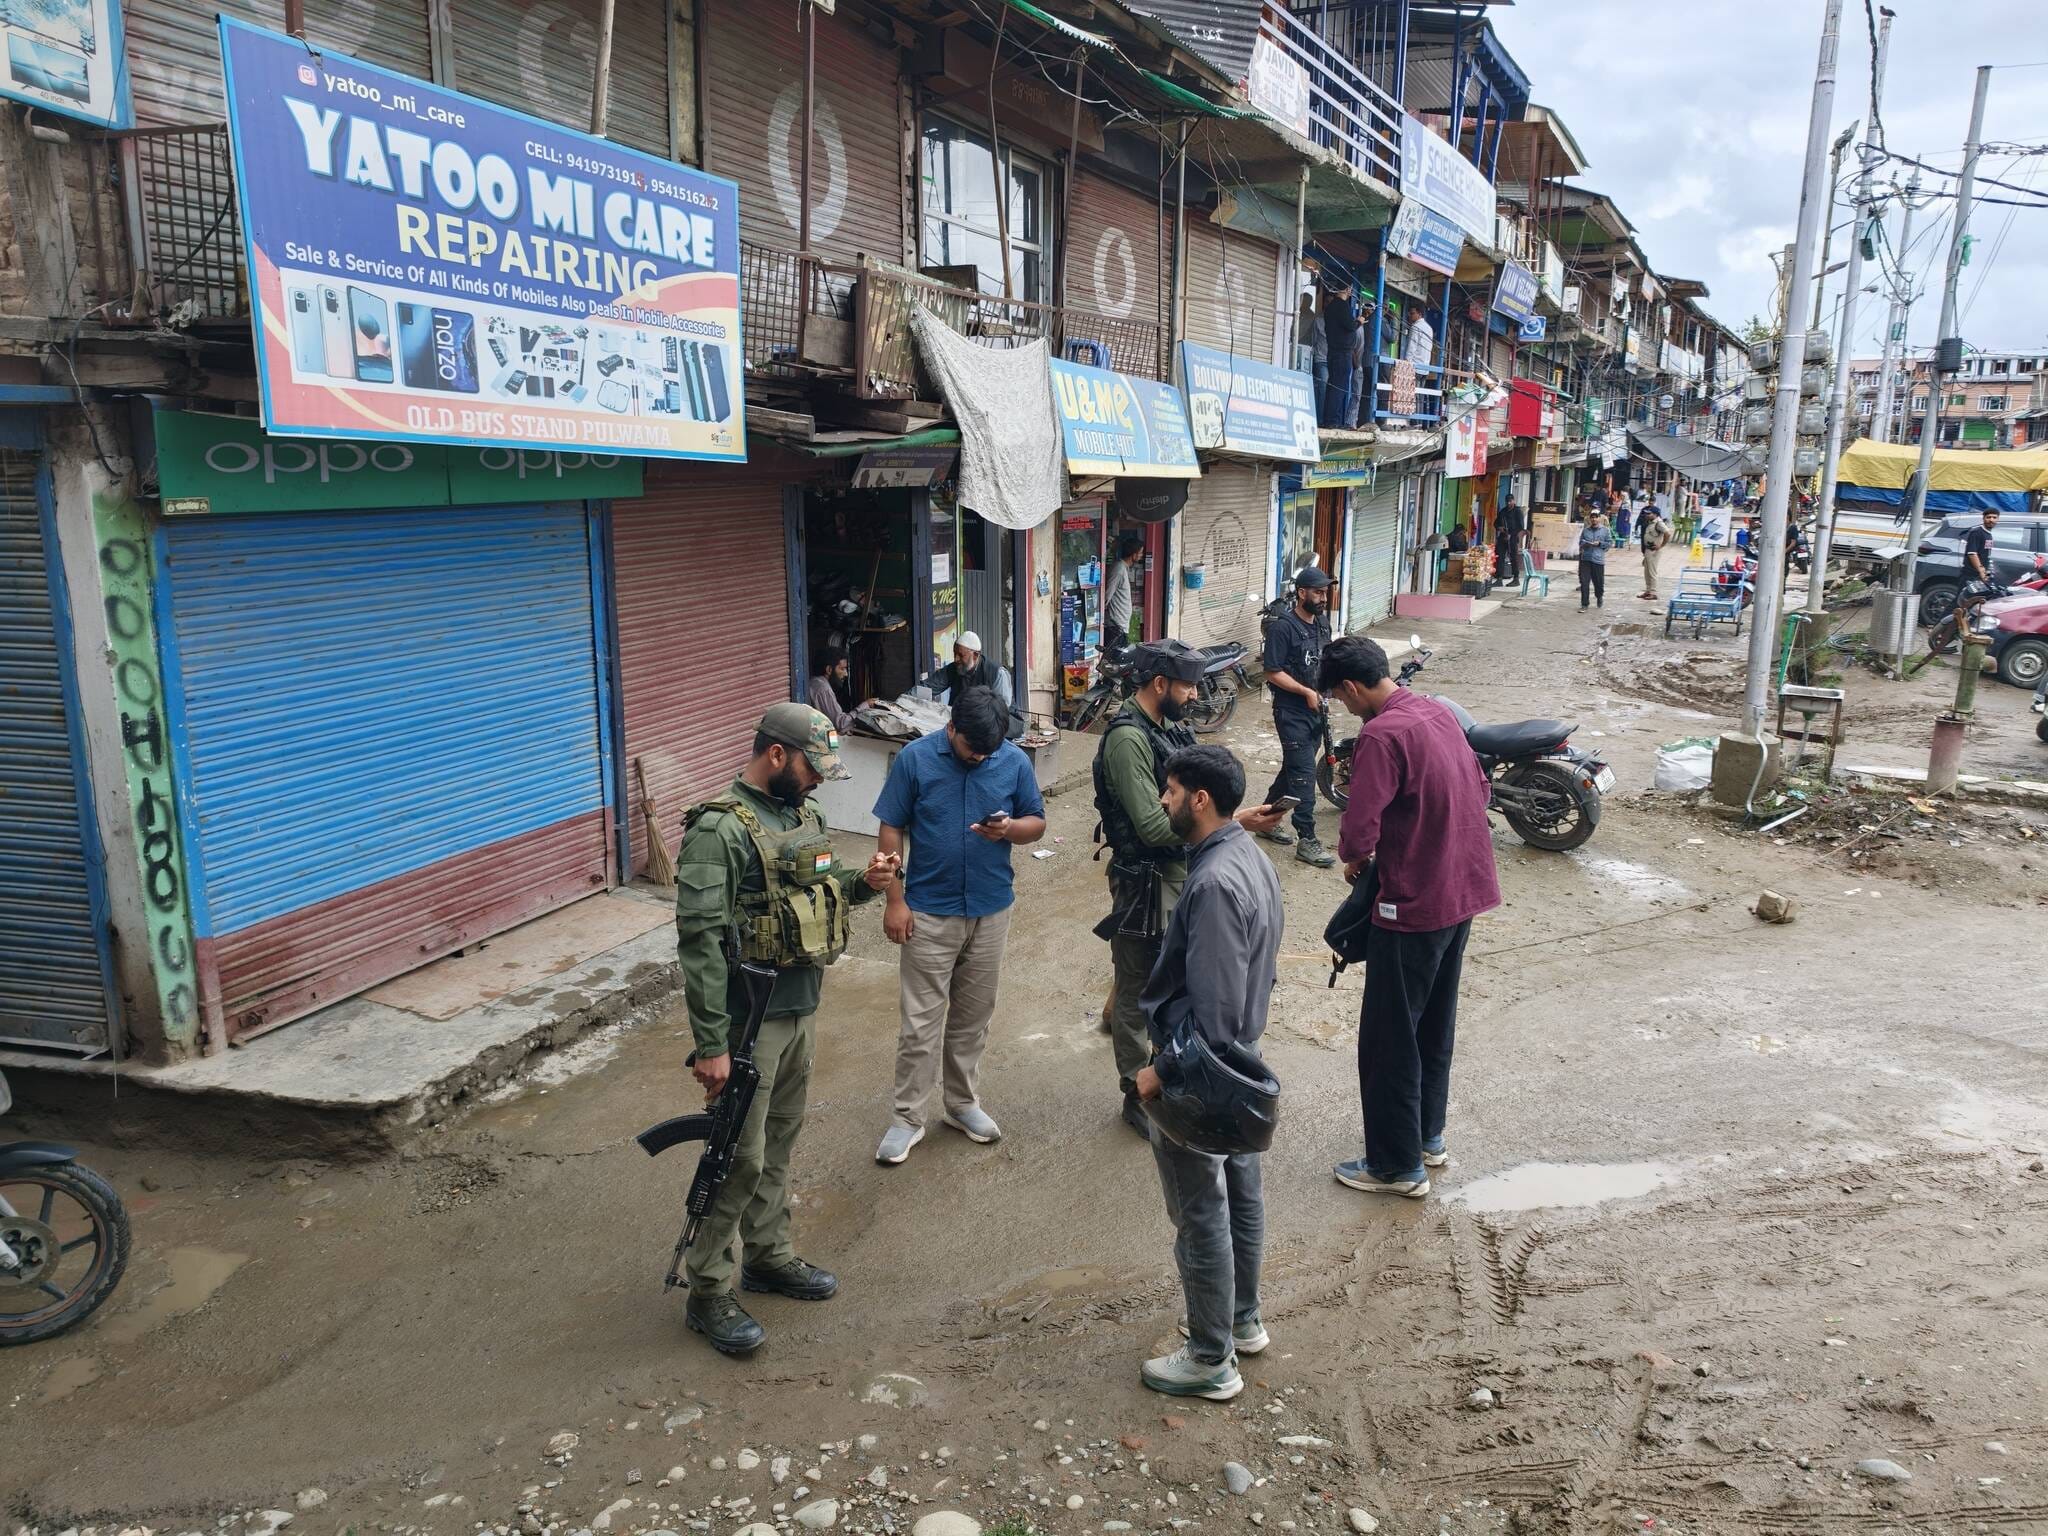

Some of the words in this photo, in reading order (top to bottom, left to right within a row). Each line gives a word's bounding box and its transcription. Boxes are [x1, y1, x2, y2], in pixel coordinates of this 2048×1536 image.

[1265, 45, 1295, 79] JAVID
[323, 72, 466, 128] yatoo_mi_care
[525, 141, 563, 164] CELL:
[1428, 145, 1464, 194] SCIENCE
[282, 95, 520, 221] YATOO
[527, 167, 595, 240] MI
[603, 192, 714, 268] CARE
[395, 203, 659, 301] REPAIRING
[285, 241, 324, 265] Sale
[328, 249, 342, 269] &
[346, 252, 404, 280] Service
[407, 265, 426, 284] Of
[429, 270, 447, 288] All
[452, 273, 490, 296] Kinds
[493, 282, 508, 299] Of
[511, 285, 558, 308] Mobiles
[561, 294, 586, 313] Also
[589, 300, 619, 319] Deals
[621, 304, 634, 322] In
[636, 306, 670, 328] Mobile
[671, 314, 726, 339] Accessories
[434, 314, 457, 380] narzo
[1246, 376, 1292, 407] ELECTRONIC
[1292, 387, 1310, 410] MALL
[407, 404, 455, 433] OLD
[460, 409, 505, 437] BUS
[511, 414, 577, 441] STAND
[581, 419, 672, 447] PULWAMA
[1073, 429, 1116, 456] MOBILE
[1116, 436, 1137, 458] HUT
[204, 442, 414, 484] oppo
[479, 447, 620, 479] oppo
